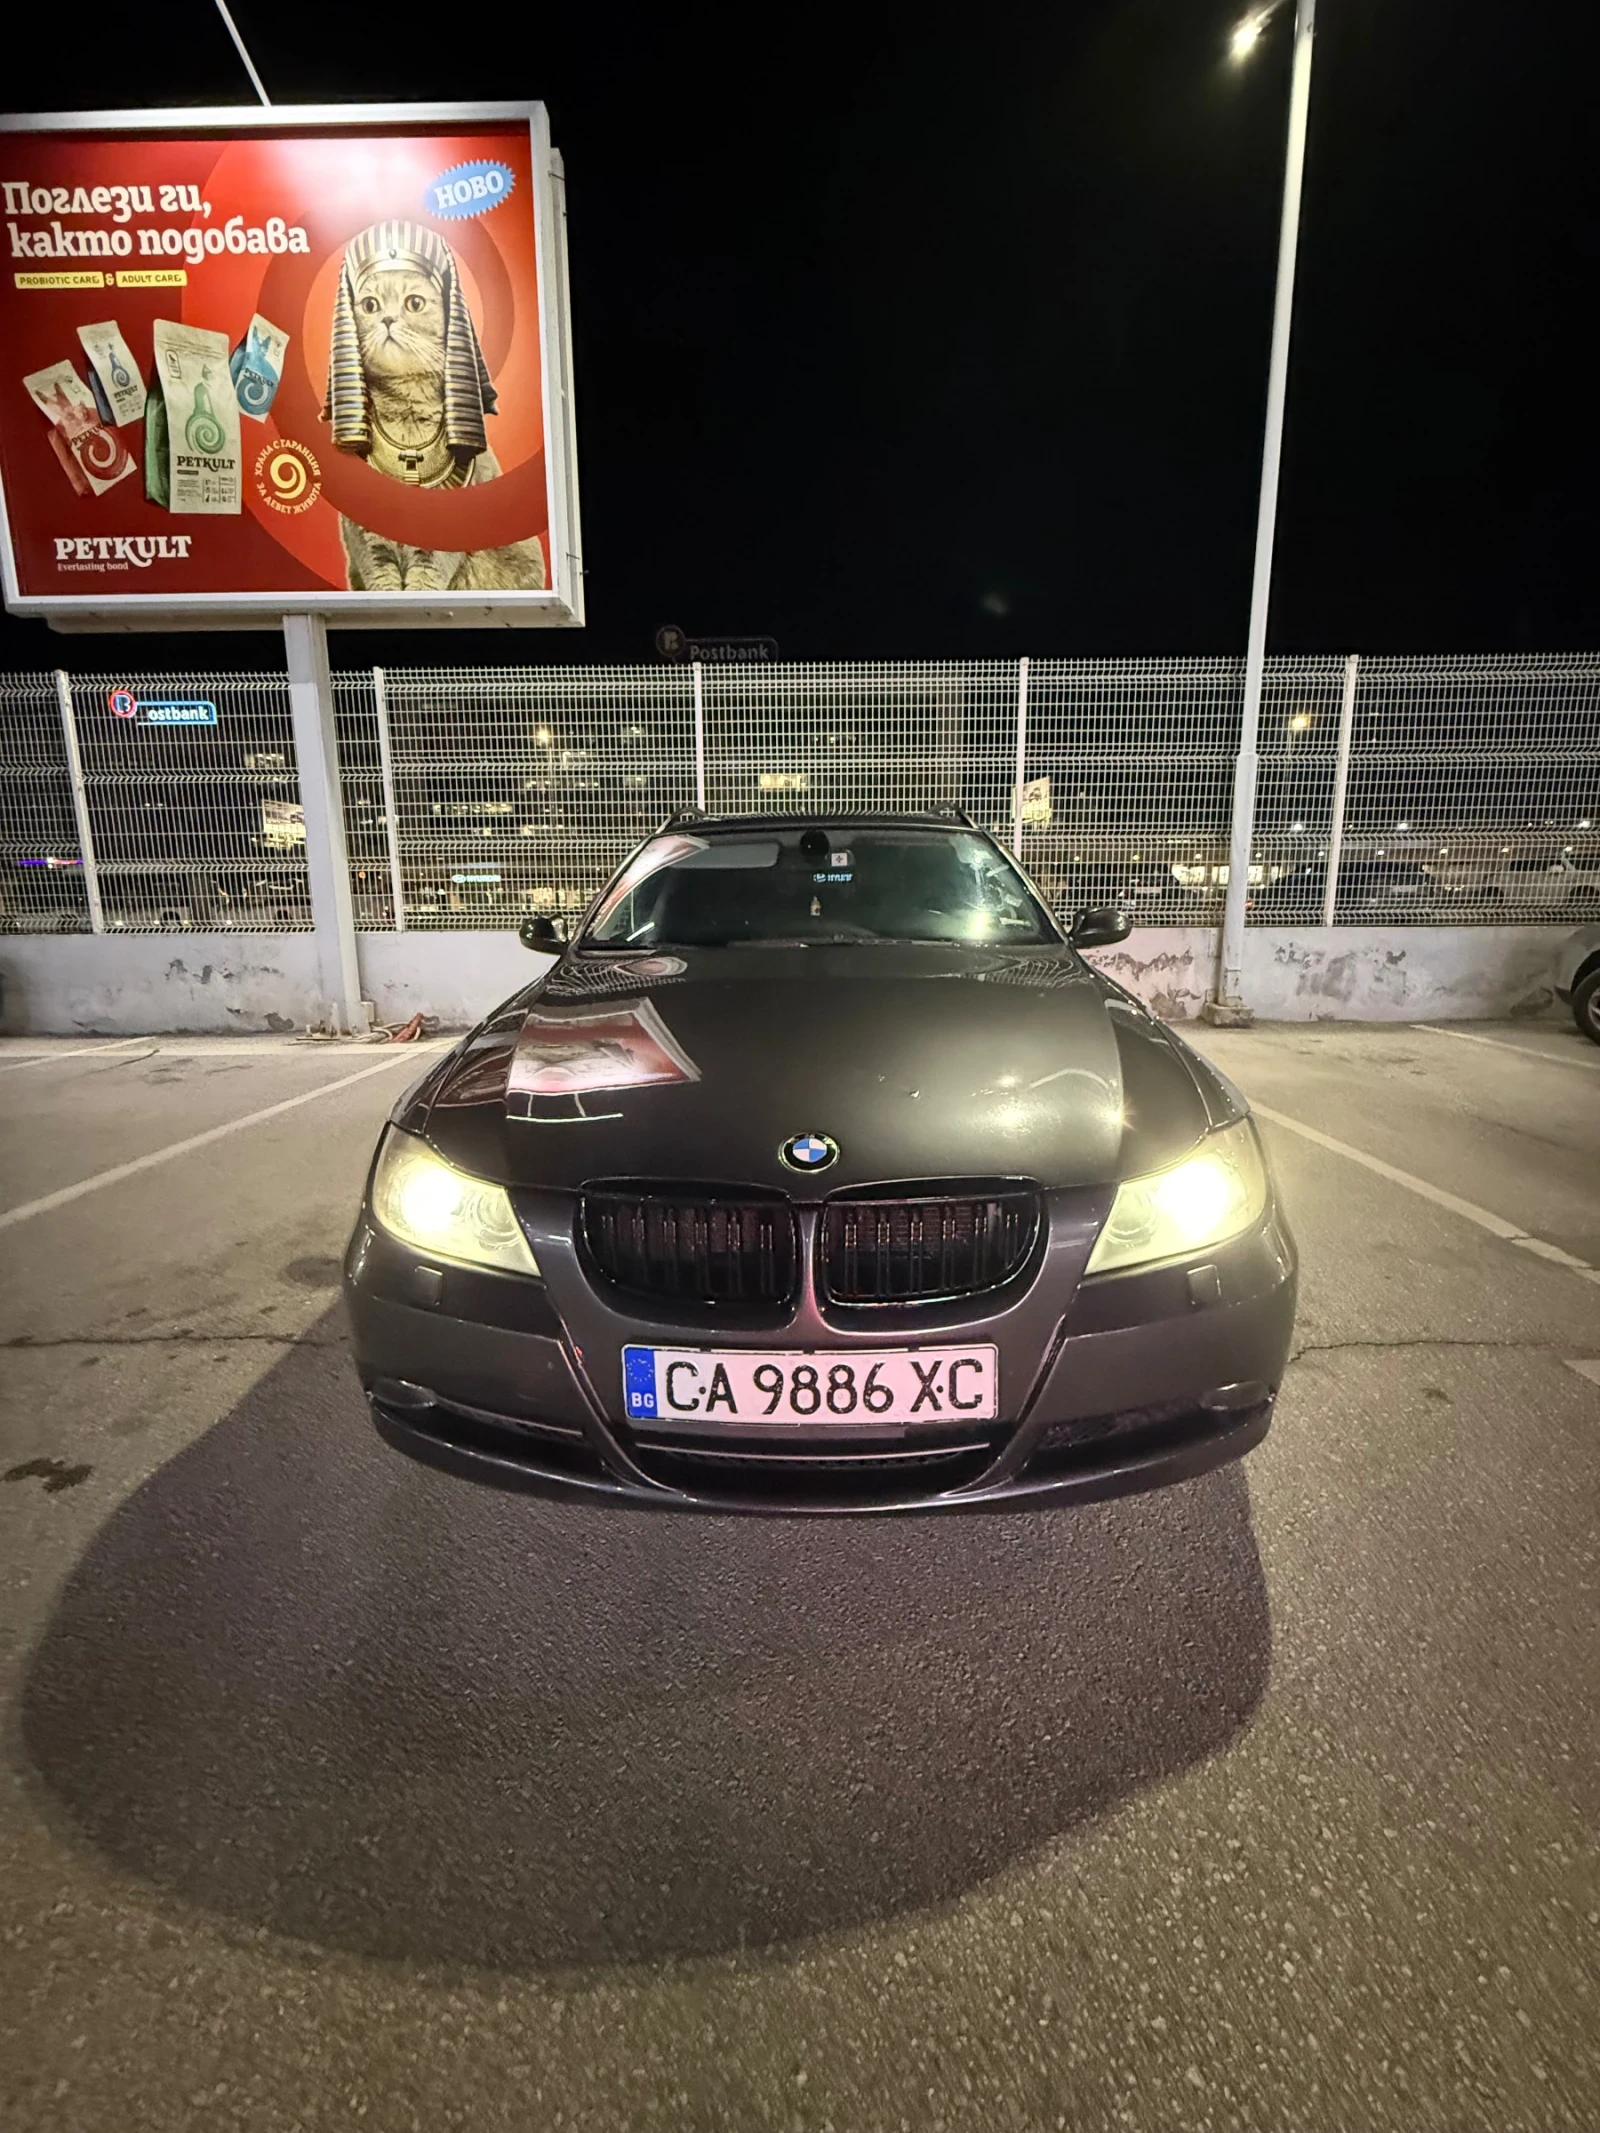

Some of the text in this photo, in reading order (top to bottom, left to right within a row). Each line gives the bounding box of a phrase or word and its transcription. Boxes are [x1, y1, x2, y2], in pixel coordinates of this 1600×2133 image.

[2, 181, 212, 223] Поглези ги,
[434, 170, 504, 210] НОВО
[7, 214, 311, 265] както подобава
[19, 276, 71, 286] PROBIOTIC
[73, 276, 100, 285] CARE
[121, 275, 152, 284] ADULT
[154, 275, 182, 283] CARE
[176, 455, 236, 472] PETKULT
[254, 444, 274, 476] ХРАНА
[280, 439, 321, 476] ГАРАНЦИЯ
[293, 482, 322, 514] ЖИВОТА
[53, 535, 192, 568] PETKULT
[57, 561, 129, 572] Everlasting bond
[689, 643, 769, 661] Postbank
[631, 1393, 655, 1409] BG
[666, 1358, 984, 1416] CA 9886 XC
